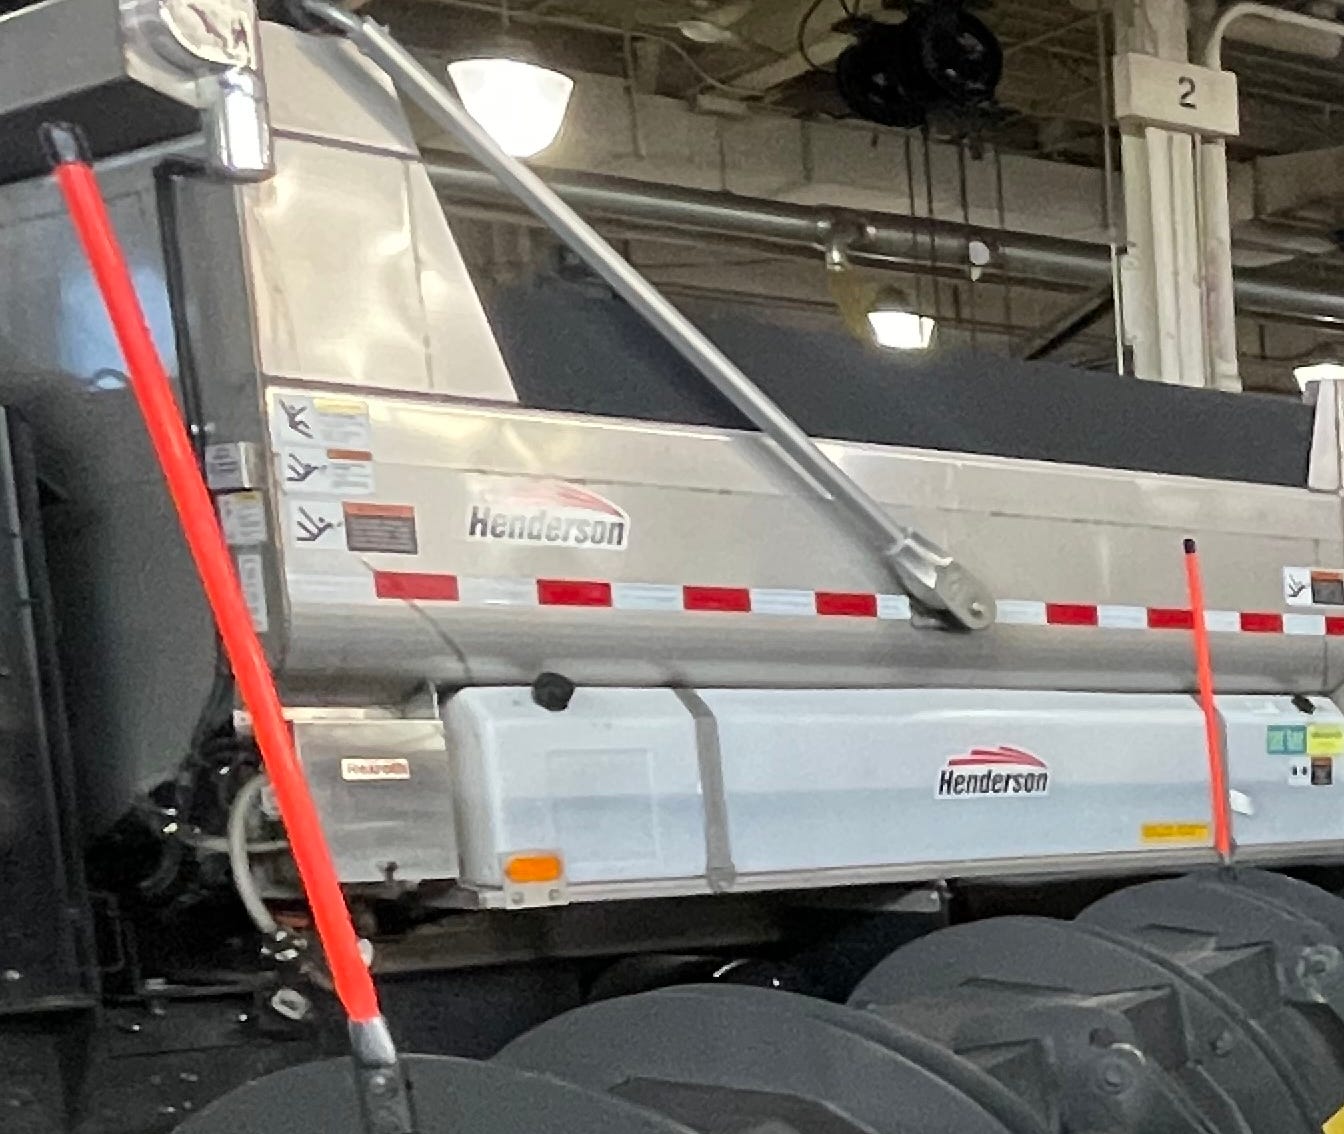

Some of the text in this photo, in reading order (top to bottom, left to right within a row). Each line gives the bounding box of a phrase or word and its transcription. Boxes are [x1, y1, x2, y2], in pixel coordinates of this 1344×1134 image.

[1178, 76, 1197, 110] 2
[468, 505, 624, 546] Henderson
[939, 769, 1048, 795] Henderson
